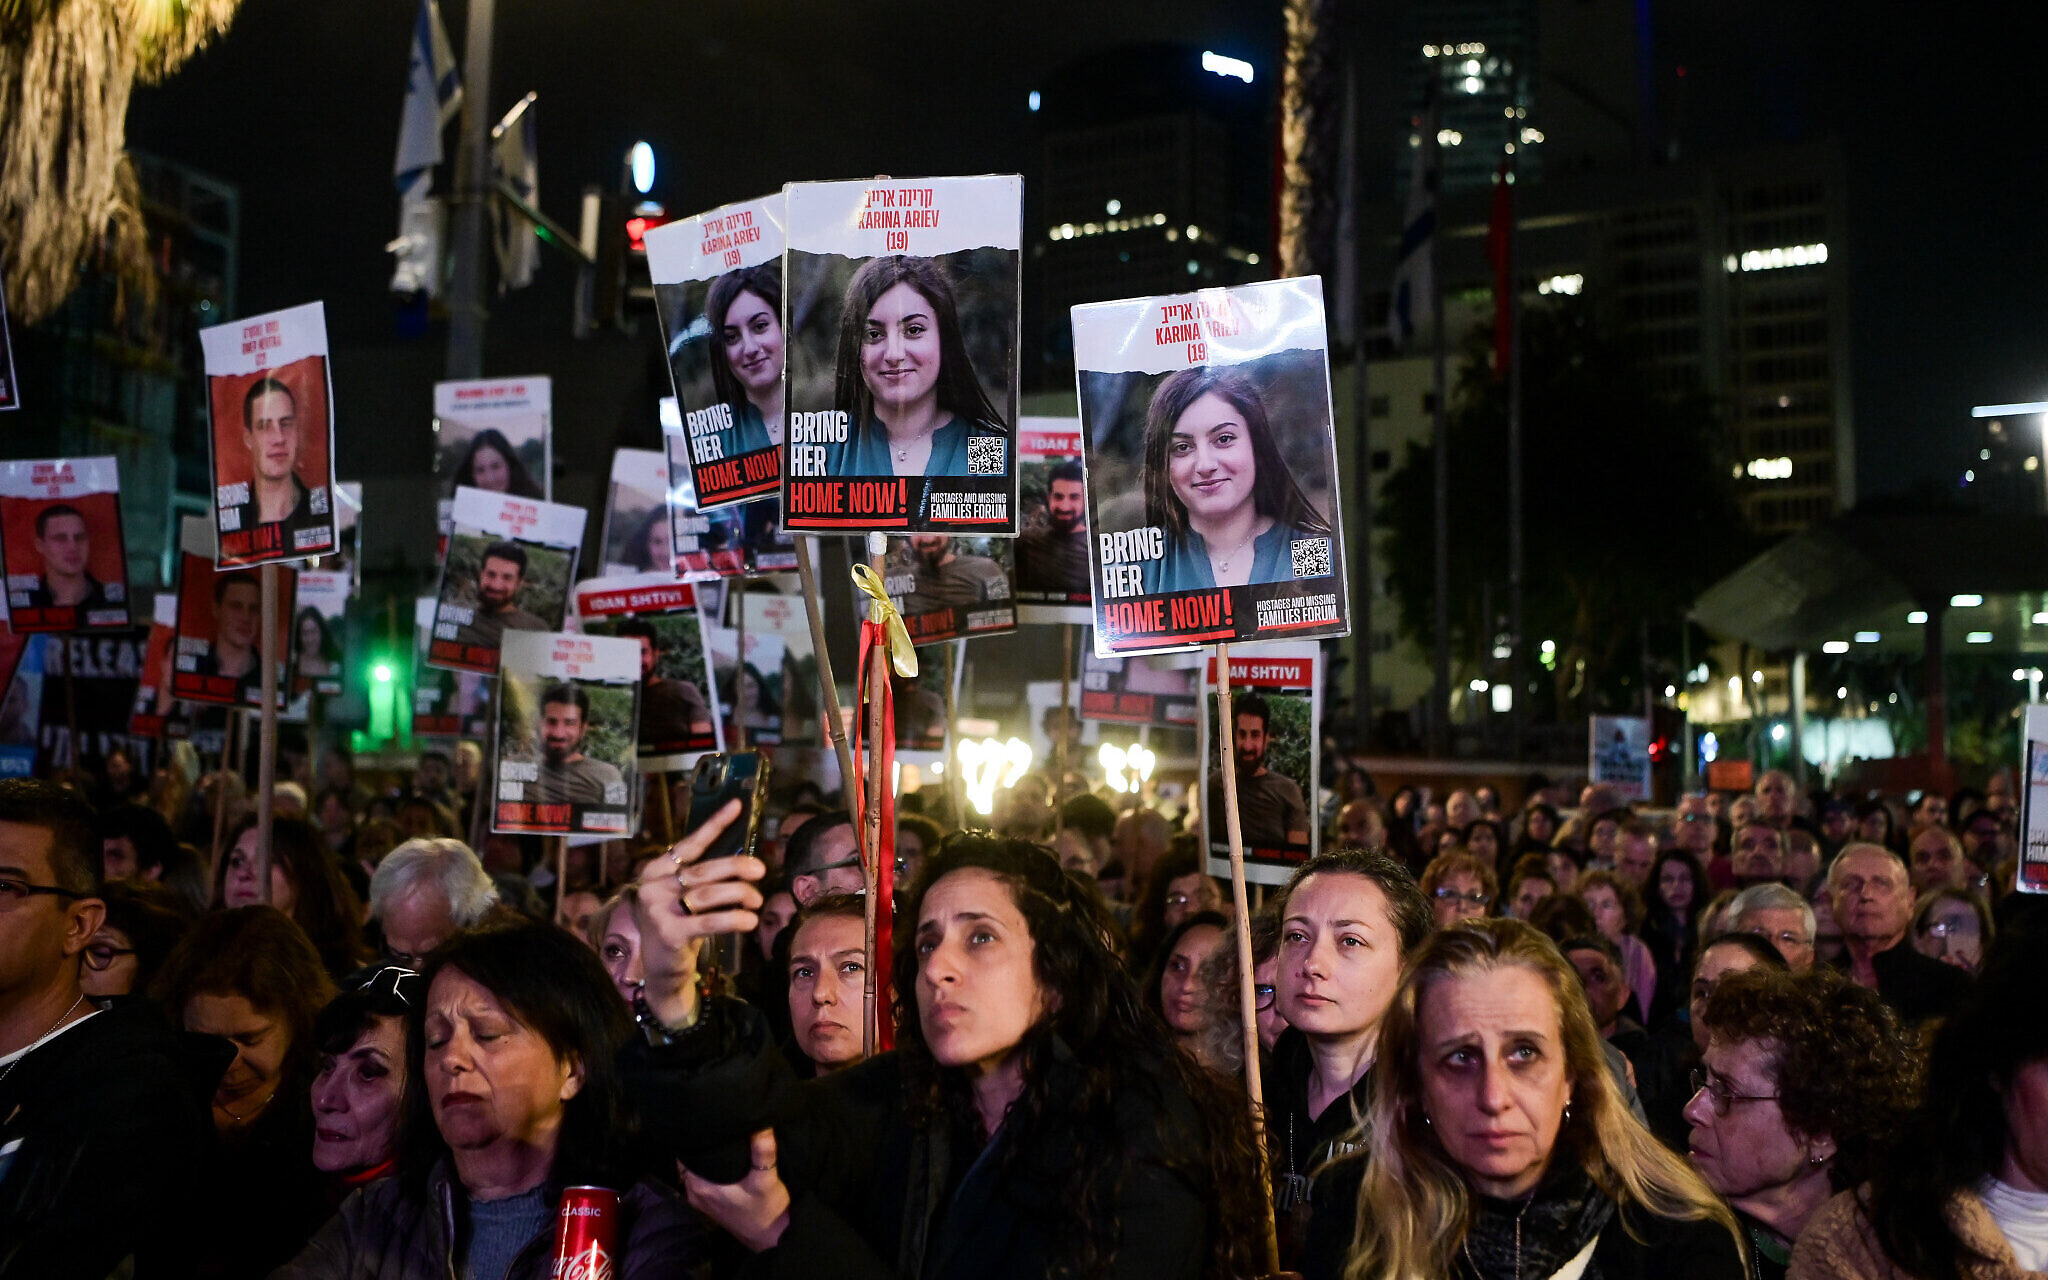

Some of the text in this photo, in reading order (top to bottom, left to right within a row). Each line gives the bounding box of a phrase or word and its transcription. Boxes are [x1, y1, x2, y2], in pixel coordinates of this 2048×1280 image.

[865, 189, 933, 208] קרינה ארייב
[858, 210, 940, 229] KARINA ARIEV
[702, 226, 760, 256] KARINA ARIEV
[887, 230, 908, 252] (19)
[724, 248, 741, 268] (19)
[1161, 303, 1193, 324] ארייב
[1155, 323, 1201, 345] KARINA
[686, 403, 733, 438] BRING
[791, 410, 848, 443] BRING
[692, 434, 724, 465] HER
[791, 446, 827, 477] HER
[698, 460, 743, 494] HOME
[790, 478, 907, 514] HOME NOW!
[930, 492, 1007, 503] HOSTAGES AND MISSING
[930, 504, 1007, 519] FAMILIES FORUM
[1099, 527, 1164, 564] BRING
[1102, 564, 1144, 598] HER
[1104, 588, 1233, 635] HOME NOW!
[1256, 593, 1336, 612] HOSTAGES AND MISSING
[1257, 605, 1337, 627] FAMILIES FORUM
[1251, 666, 1300, 680] SHTIVI
[562, 1206, 601, 1217] CLASSIC
